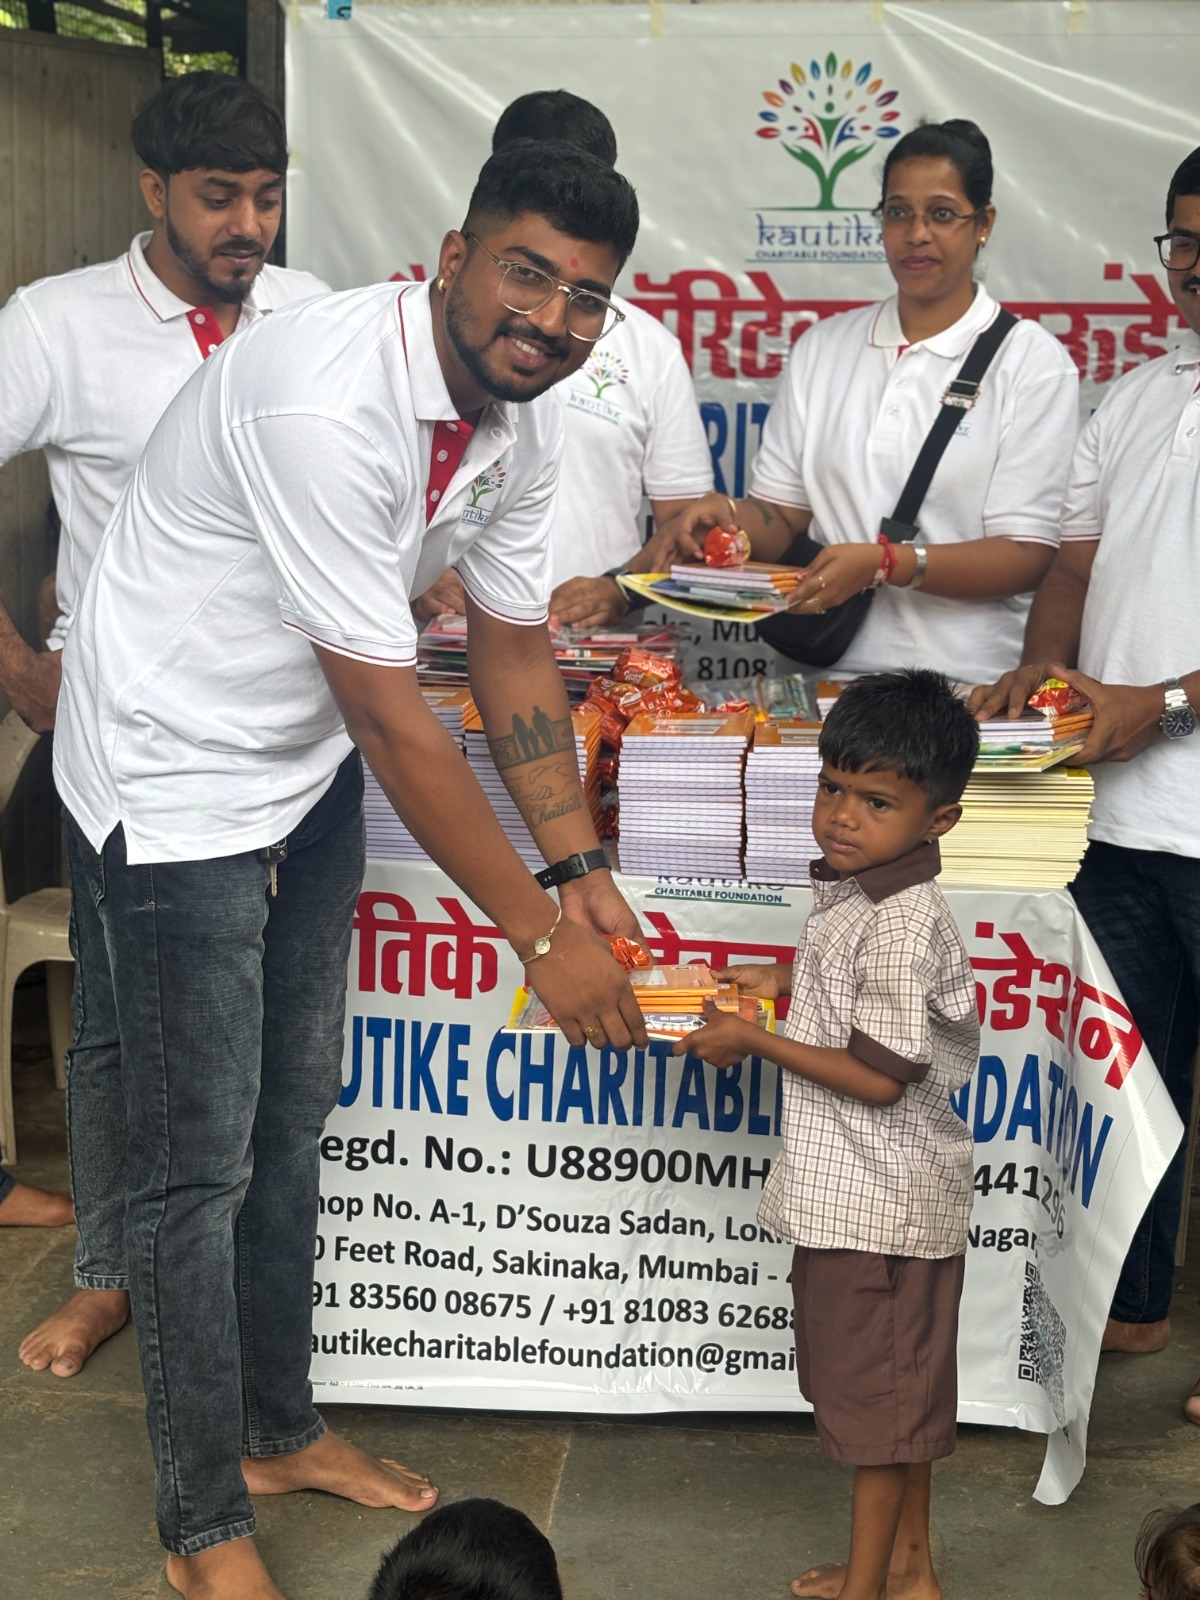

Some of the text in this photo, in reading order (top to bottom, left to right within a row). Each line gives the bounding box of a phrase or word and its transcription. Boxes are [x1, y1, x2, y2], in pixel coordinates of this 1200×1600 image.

[755, 250, 885, 260] CHARITABLE FOUNDATIO
[697, 656, 774, 681] 8108
[654, 887, 783, 903] CHARITABLE FOUNDATION
[320, 1129, 409, 1172] egd.
[424, 1136, 512, 1176] No.:
[527, 1143, 771, 1190] U88900MH
[373, 1193, 421, 1221] No.
[430, 1199, 487, 1231] A-1,
[619, 1209, 715, 1244] Sadan,
[335, 1236, 396, 1265] Feet
[404, 1240, 483, 1277] Road,
[492, 1249, 629, 1283] Sakinaka,
[638, 1254, 759, 1286] Mumbai
[349, 1282, 437, 1313] 83560
[445, 1289, 532, 1319] 08675
[539, 1293, 556, 1326] /
[563, 1298, 615, 1325] +91
[624, 1297, 709, 1326] 81083
